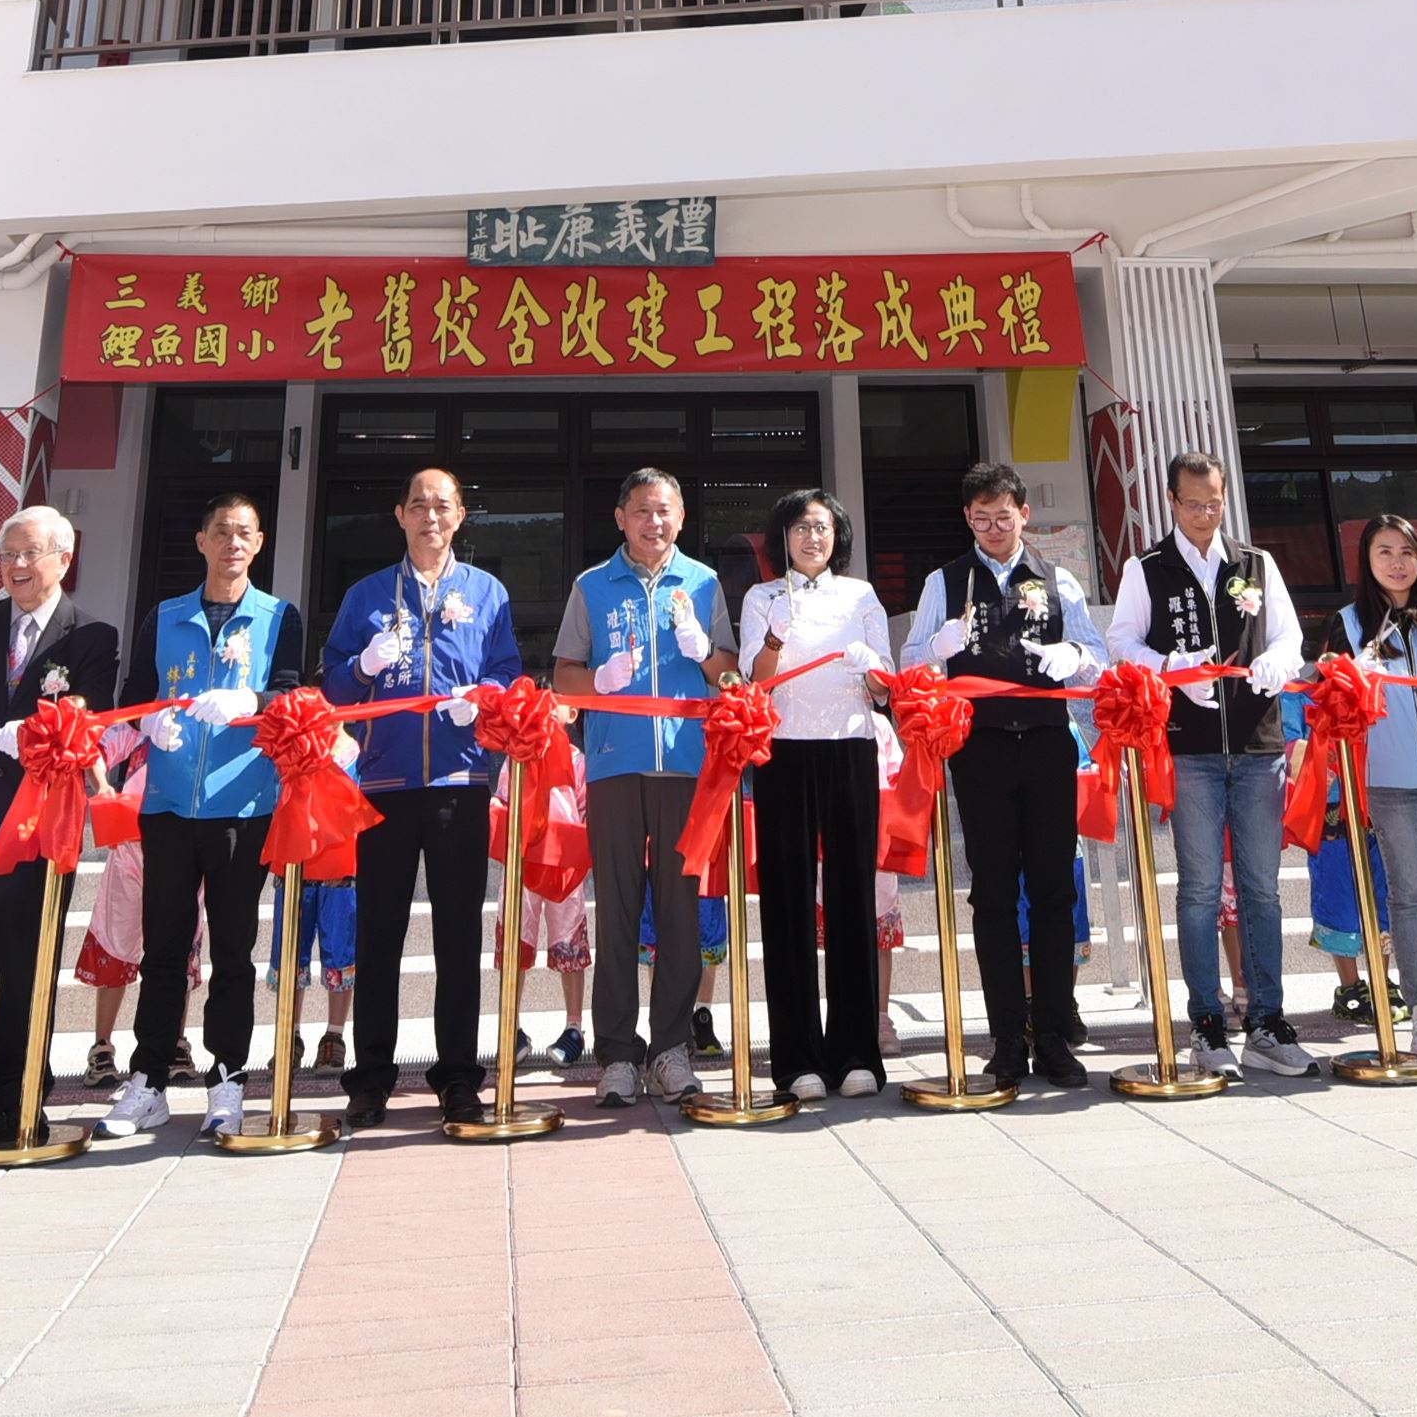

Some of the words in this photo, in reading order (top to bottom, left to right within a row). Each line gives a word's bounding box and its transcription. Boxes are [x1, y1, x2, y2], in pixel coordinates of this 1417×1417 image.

[104, 271, 280, 316] 三義鄉
[98, 321, 276, 368] 鯉魚國小
[304, 269, 1053, 374] 老舊校舍改建工程落成典禮
